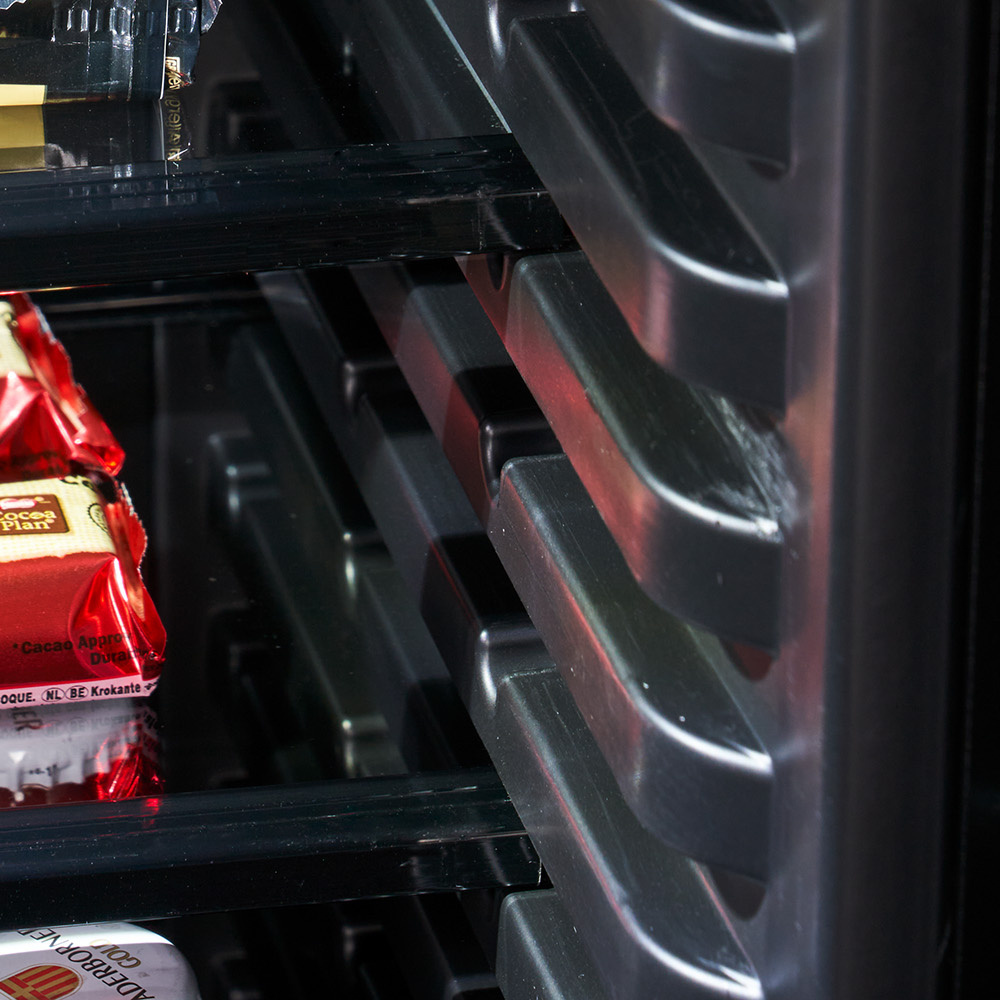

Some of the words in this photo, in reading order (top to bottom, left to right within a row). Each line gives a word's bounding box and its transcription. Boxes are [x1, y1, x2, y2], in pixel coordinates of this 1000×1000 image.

[1, 518, 51, 531] Plan
[46, 690, 64, 701] NL
[70, 688, 85, 699] BE
[90, 682, 141, 697] Krokante
